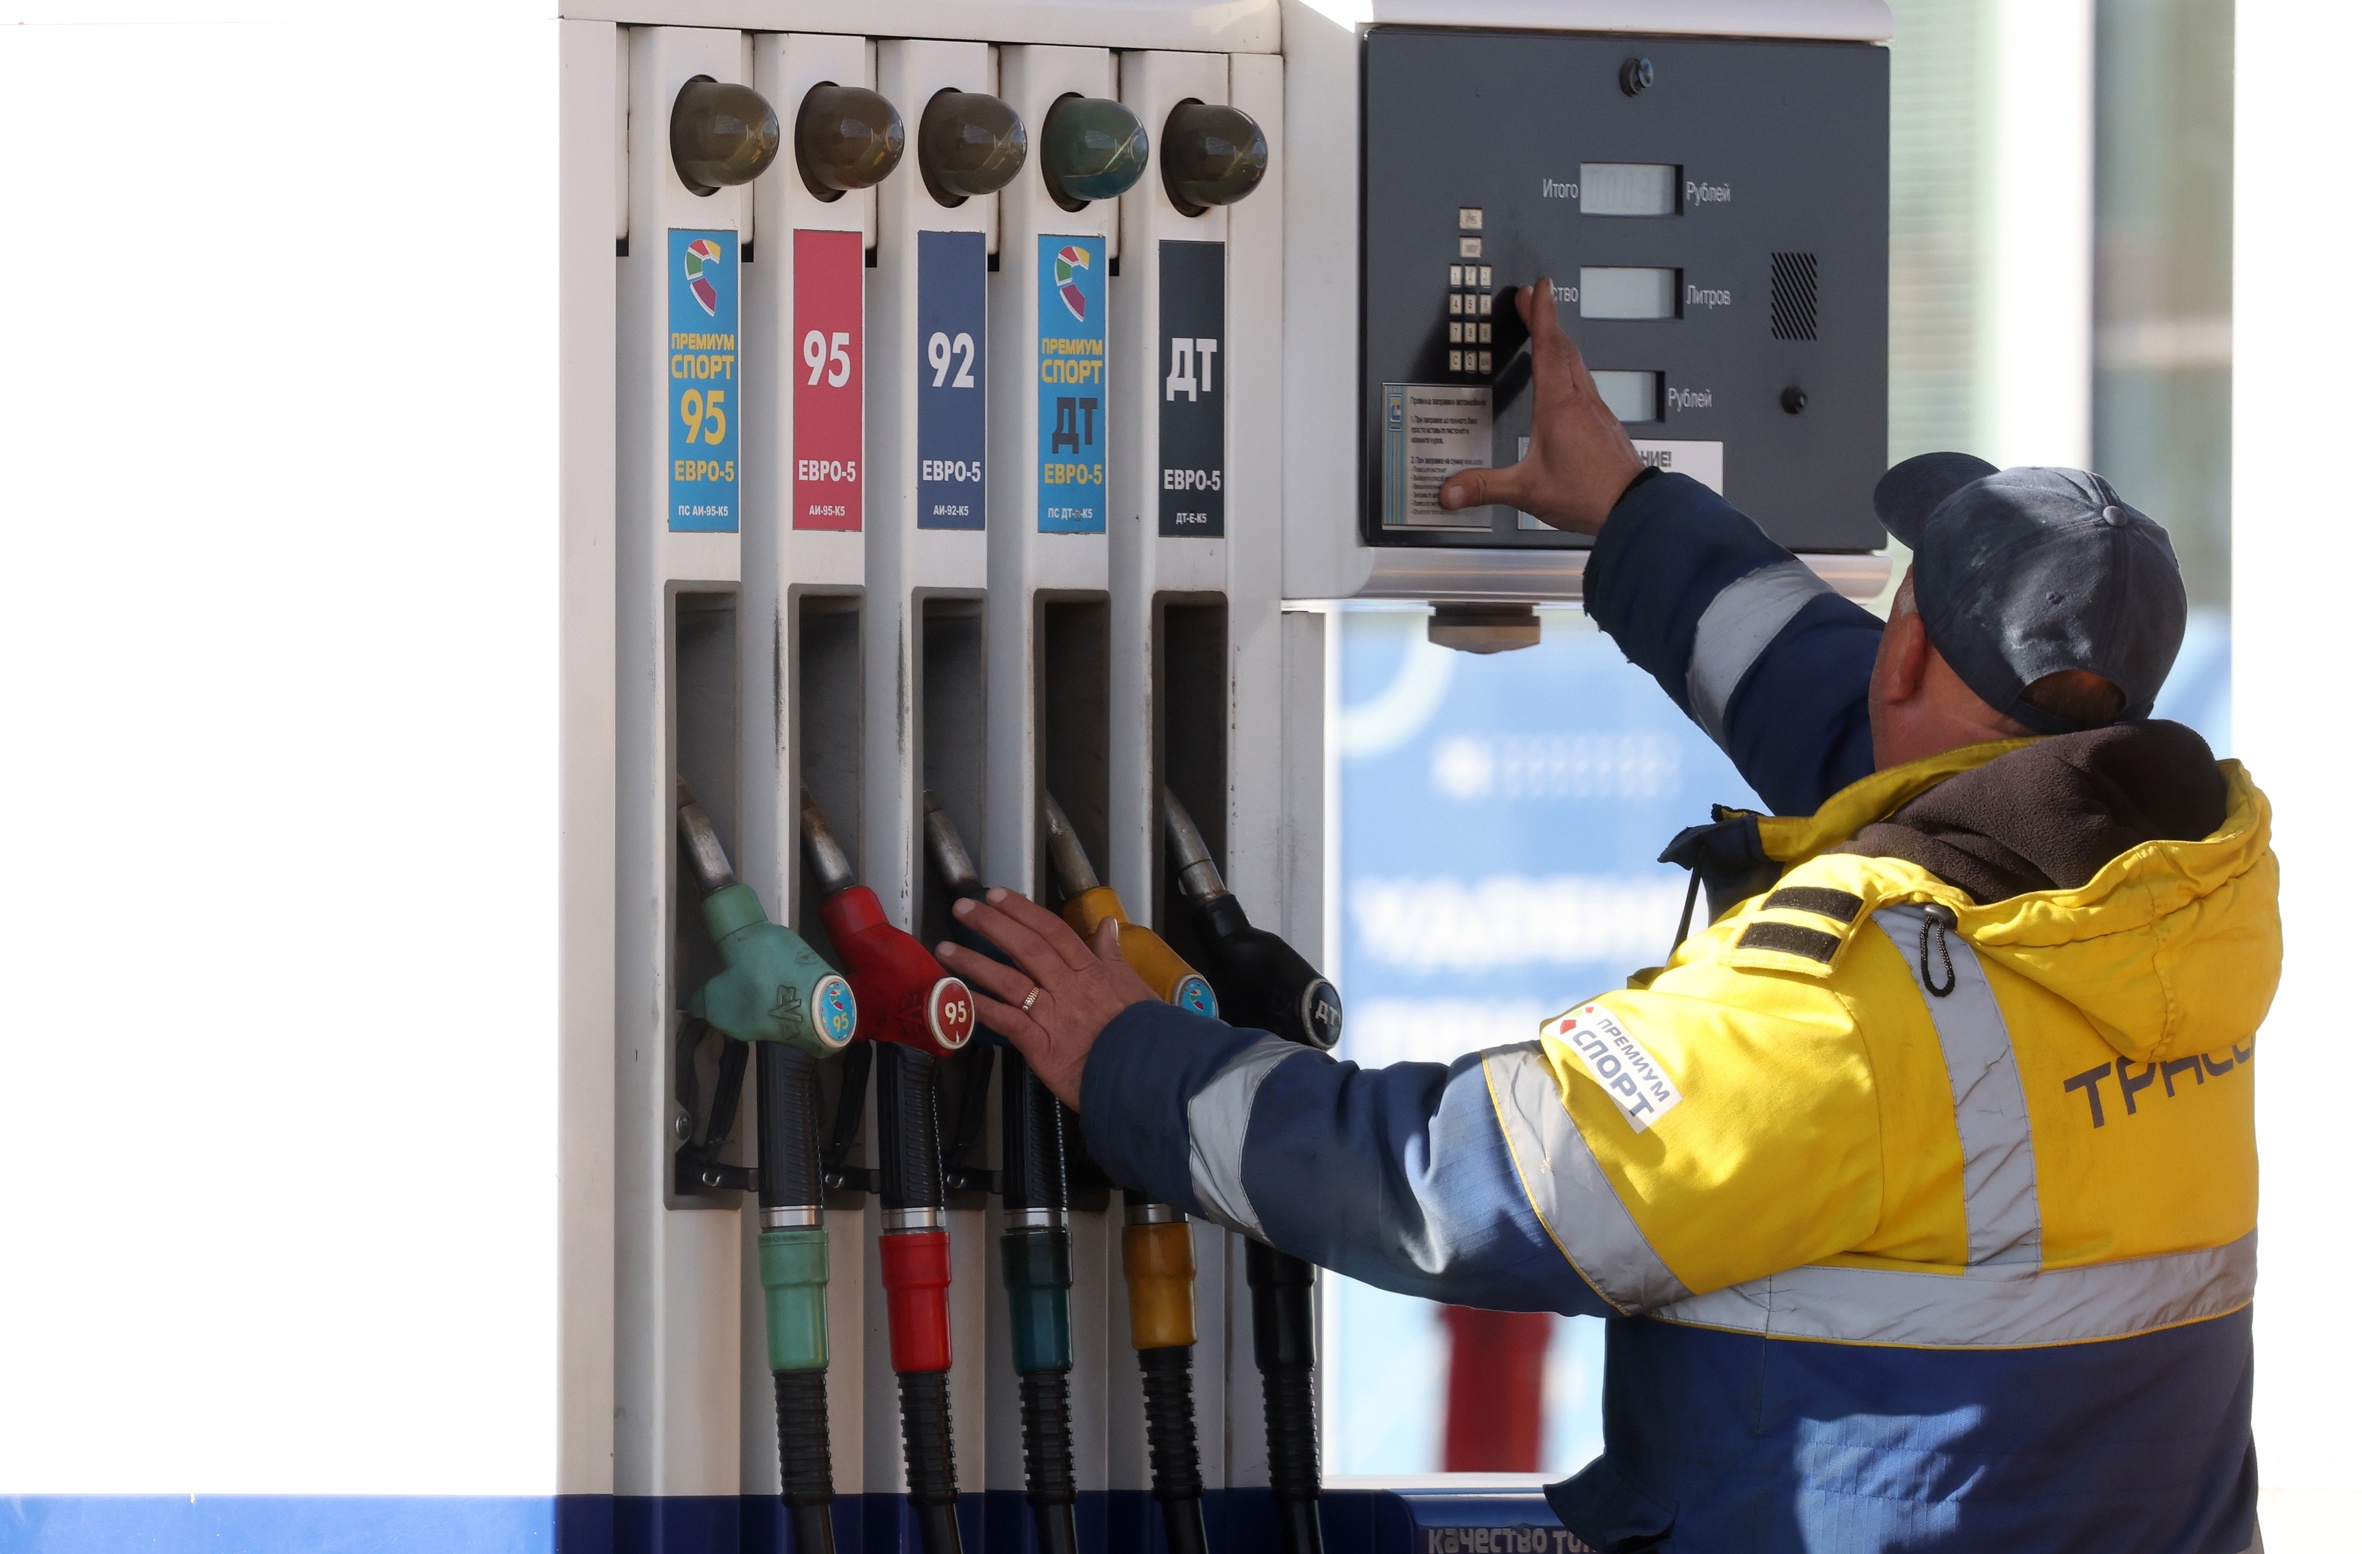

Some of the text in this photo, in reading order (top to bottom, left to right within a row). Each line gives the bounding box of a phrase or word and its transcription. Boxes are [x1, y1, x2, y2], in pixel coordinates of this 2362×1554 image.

[1543, 178, 1579, 199] Итого
[1686, 181, 1731, 206] Рублей
[1552, 286, 1579, 303] ство
[1686, 285, 1731, 309] Литров
[671, 333, 735, 351] ПРЕМИУМ
[1041, 337, 1103, 356] ПРЕМИУМ
[671, 354, 735, 380] СПОРТ
[803, 330, 851, 388] 95
[927, 331, 975, 389] 92
[1166, 337, 1218, 402] ДТ
[1041, 359, 1103, 385] СПОРТ
[1668, 387, 1713, 413] Рублей
[680, 388, 726, 446] 95
[1052, 397, 1098, 455] ДТ
[1640, 450, 1672, 468] НИЕ!
[674, 460, 735, 482] ЕВРО-5
[798, 460, 857, 482] ЕВРО-5
[922, 460, 981, 483] ЕВРО-5
[1044, 463, 1103, 485] ЕВРО-5
[1163, 469, 1221, 491] ЕВРО-5
[678, 504, 729, 517] ПС АИ-95-К5
[808, 505, 846, 517] АИ-95-К5
[933, 504, 969, 517] АИ-92-К5
[1047, 507, 1060, 519] ПС
[833, 1011, 850, 1033] 95
[944, 1000, 968, 1025] 95
[1315, 999, 1338, 1026] ДТ
[1596, 1018, 1671, 1103] ПРЕМИУМ
[1572, 1029, 1655, 1118] СПОРТ
[1428, 1528, 1598, 1554] качество то
